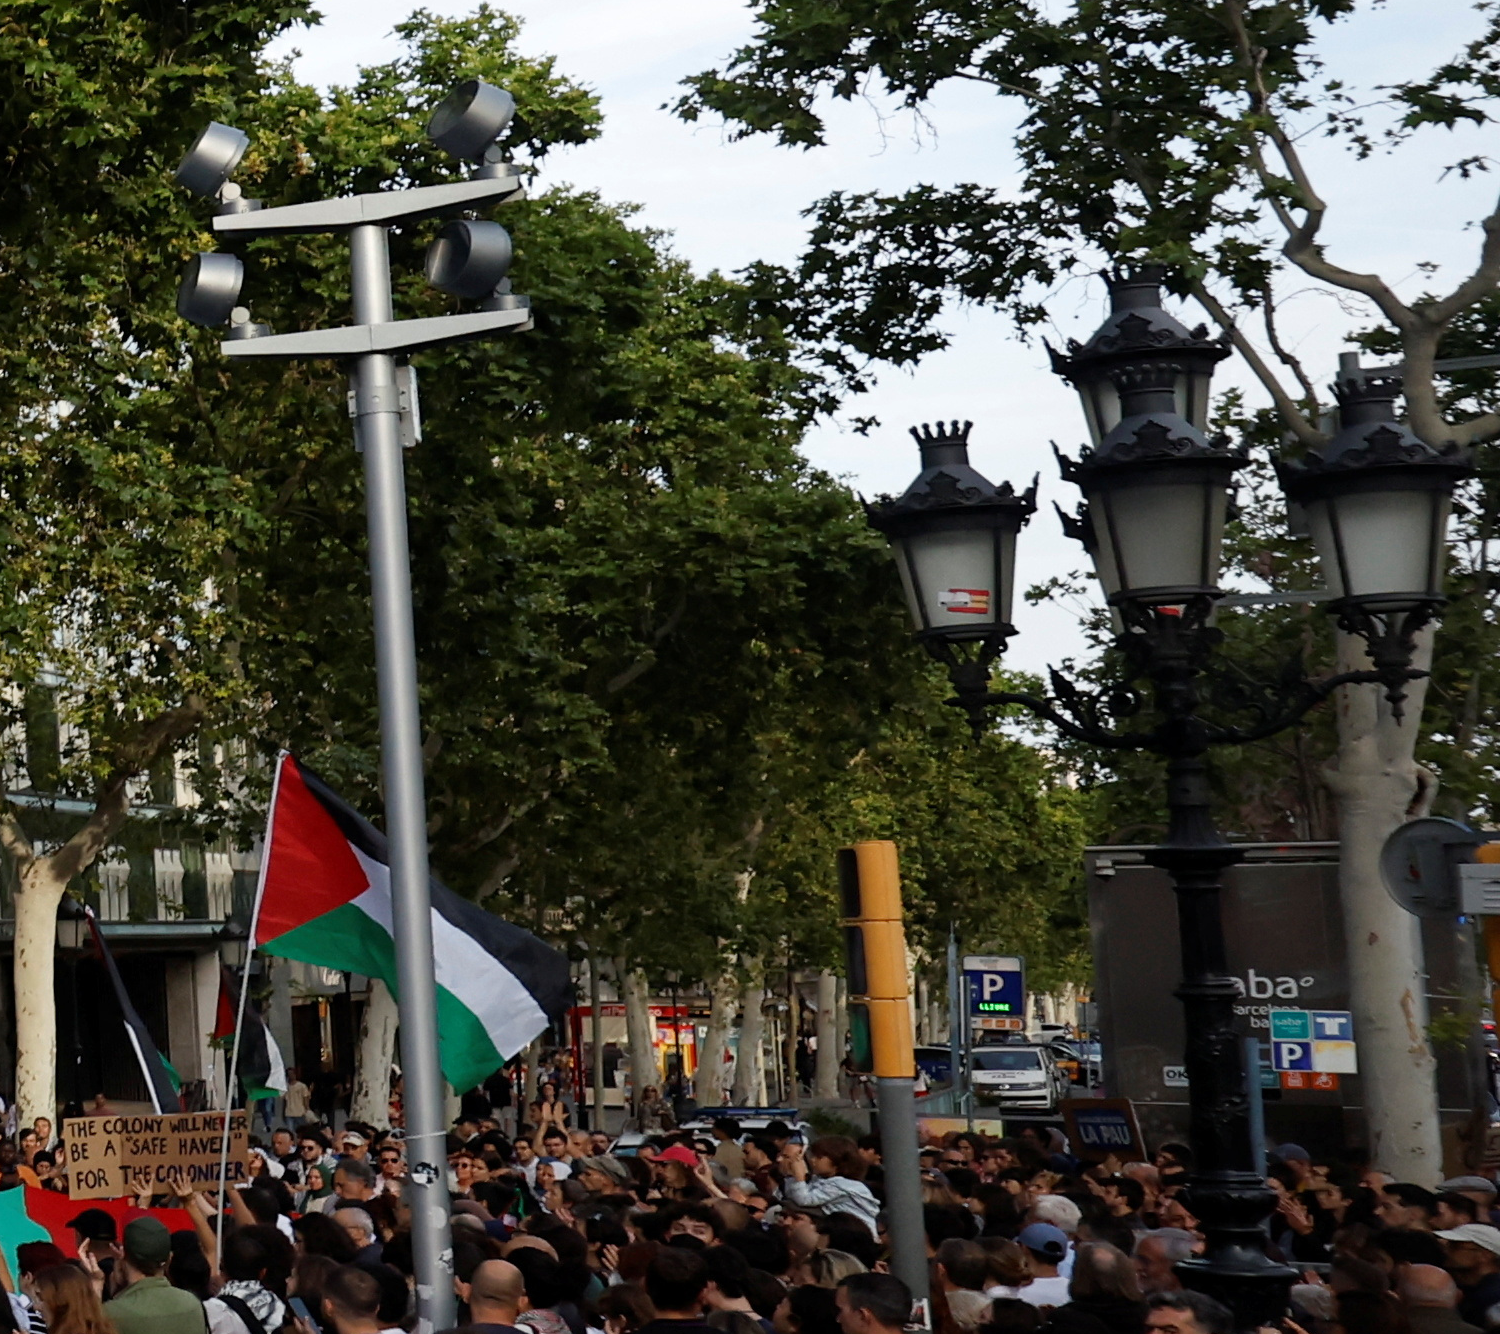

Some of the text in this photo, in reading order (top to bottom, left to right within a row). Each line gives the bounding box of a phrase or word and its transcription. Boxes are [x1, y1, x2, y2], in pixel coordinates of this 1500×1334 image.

[982, 973, 1004, 1001] P
[1280, 1043, 1303, 1069] P
[67, 1120, 97, 1138] THE
[103, 1117, 163, 1135] COLONY
[169, 1116, 199, 1133] WILL
[1100, 1125, 1132, 1145] PAU
[71, 1142, 89, 1162] BE
[104, 1140, 116, 1157] A
[76, 1161, 245, 1190] FOR THE COLONIZER
